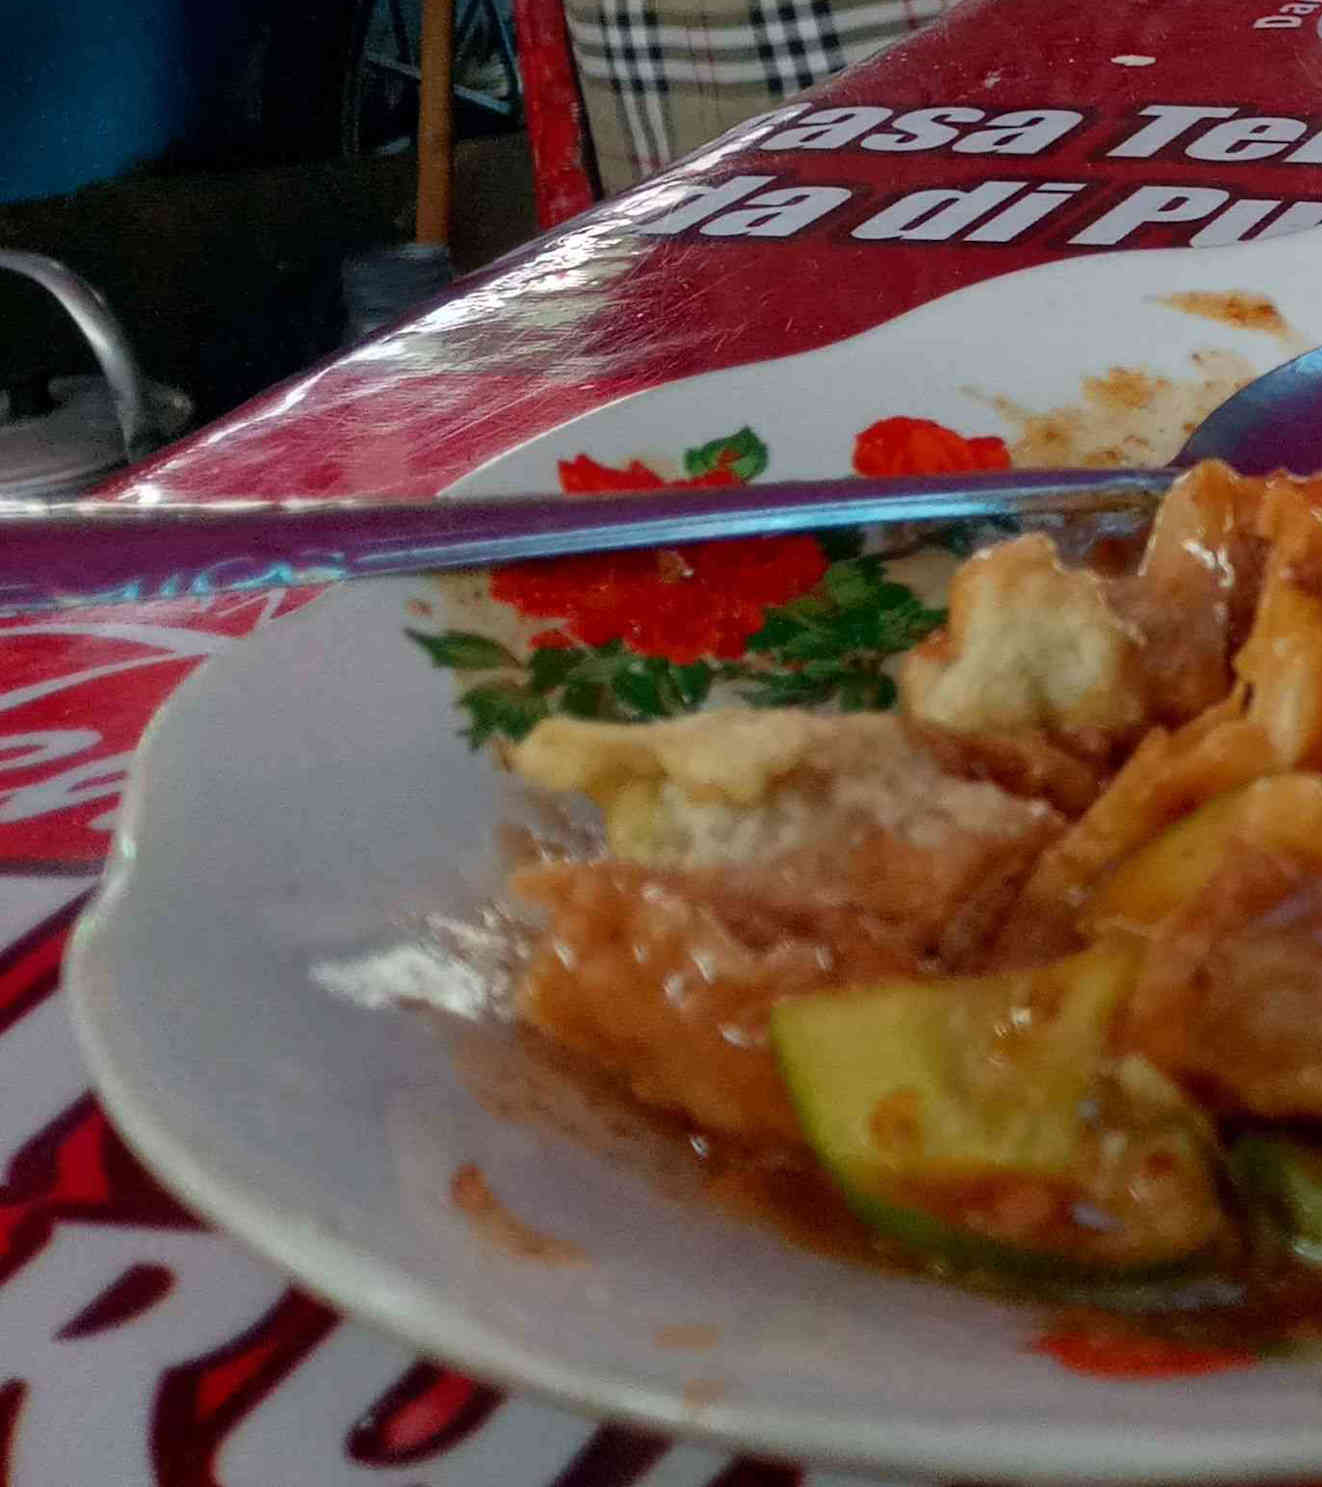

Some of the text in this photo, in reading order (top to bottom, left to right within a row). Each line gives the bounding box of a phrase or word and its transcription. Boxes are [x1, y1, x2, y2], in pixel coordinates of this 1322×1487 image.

[757, 102, 1085, 152] asa
[640, 176, 852, 237] da
[852, 179, 1088, 243] di
